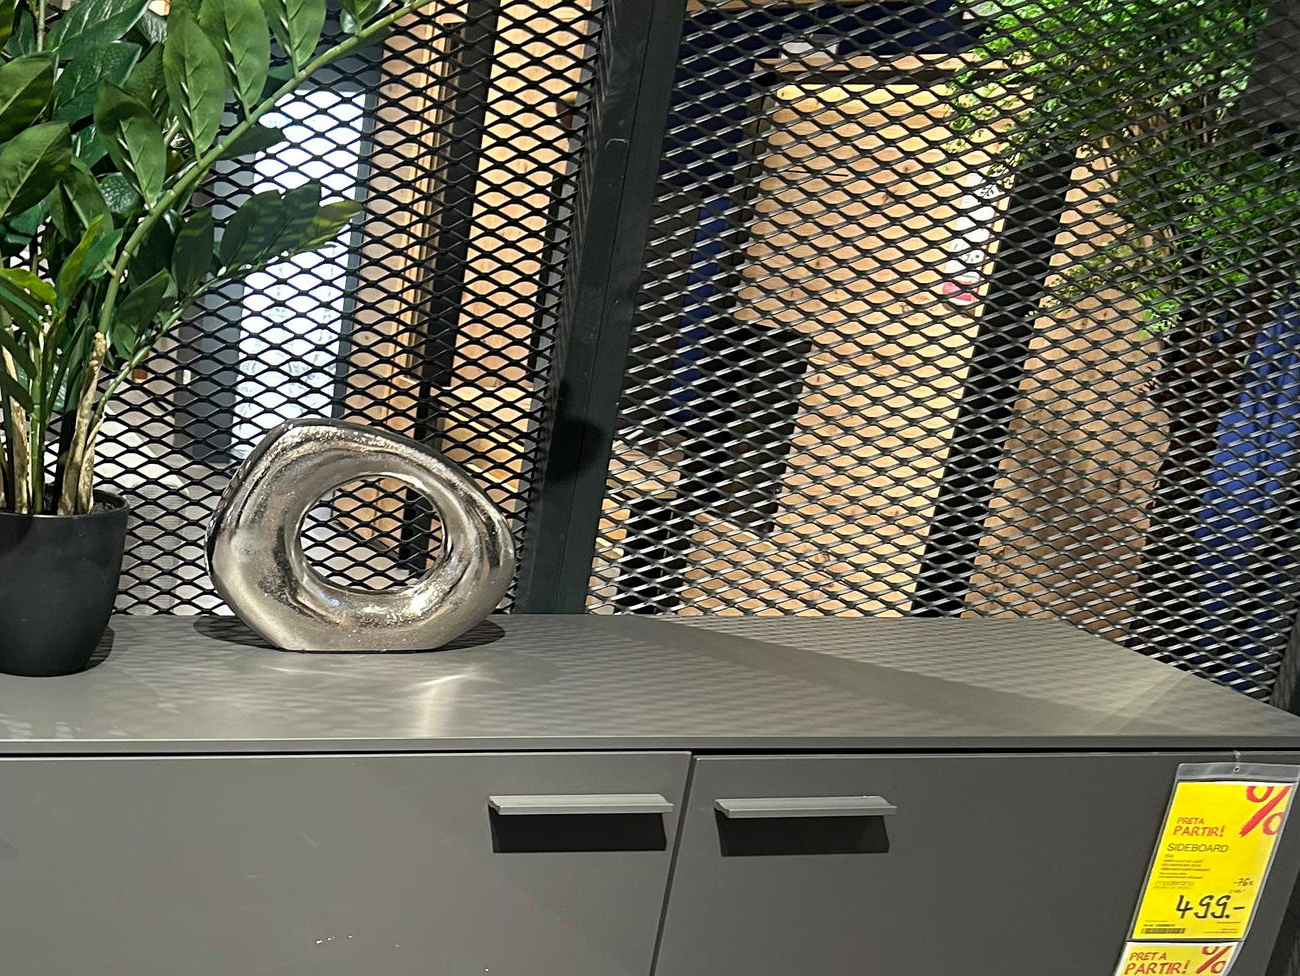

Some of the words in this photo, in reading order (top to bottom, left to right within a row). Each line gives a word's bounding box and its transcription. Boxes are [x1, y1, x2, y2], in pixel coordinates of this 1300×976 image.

[1172, 825, 1226, 837] PARTIR!
[1167, 843, 1229, 853] SIDEBOARD
[1129, 951, 1158, 961] PRET
[1124, 959, 1191, 976] PARTIR!
